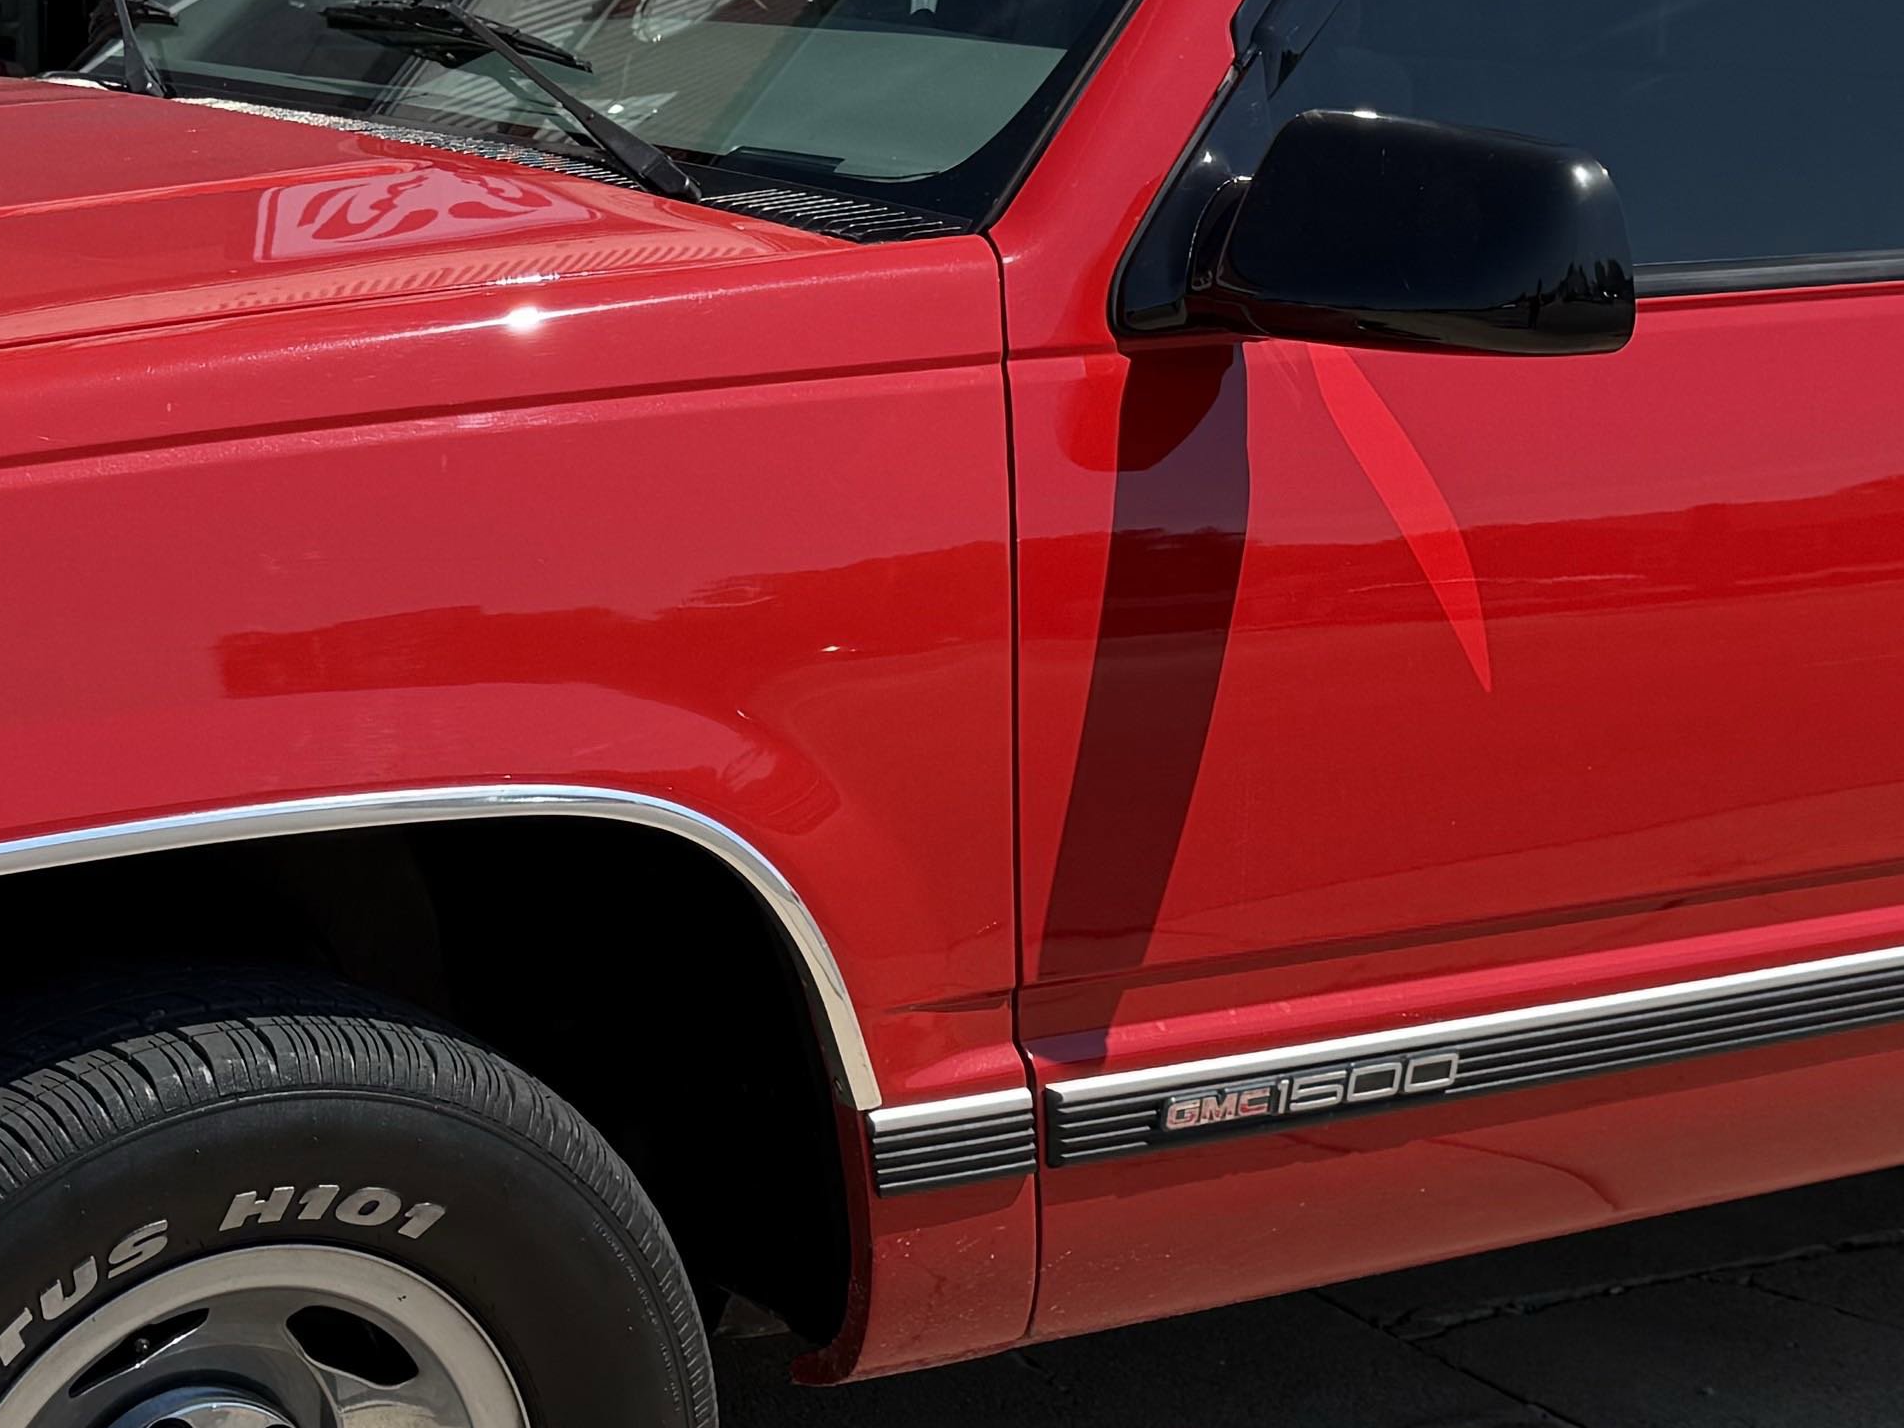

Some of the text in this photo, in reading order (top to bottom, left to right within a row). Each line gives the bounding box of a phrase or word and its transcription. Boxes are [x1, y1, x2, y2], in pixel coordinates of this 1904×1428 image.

[1165, 1051, 1460, 1130] GMC 1500
[218, 1183, 447, 1242] H101
